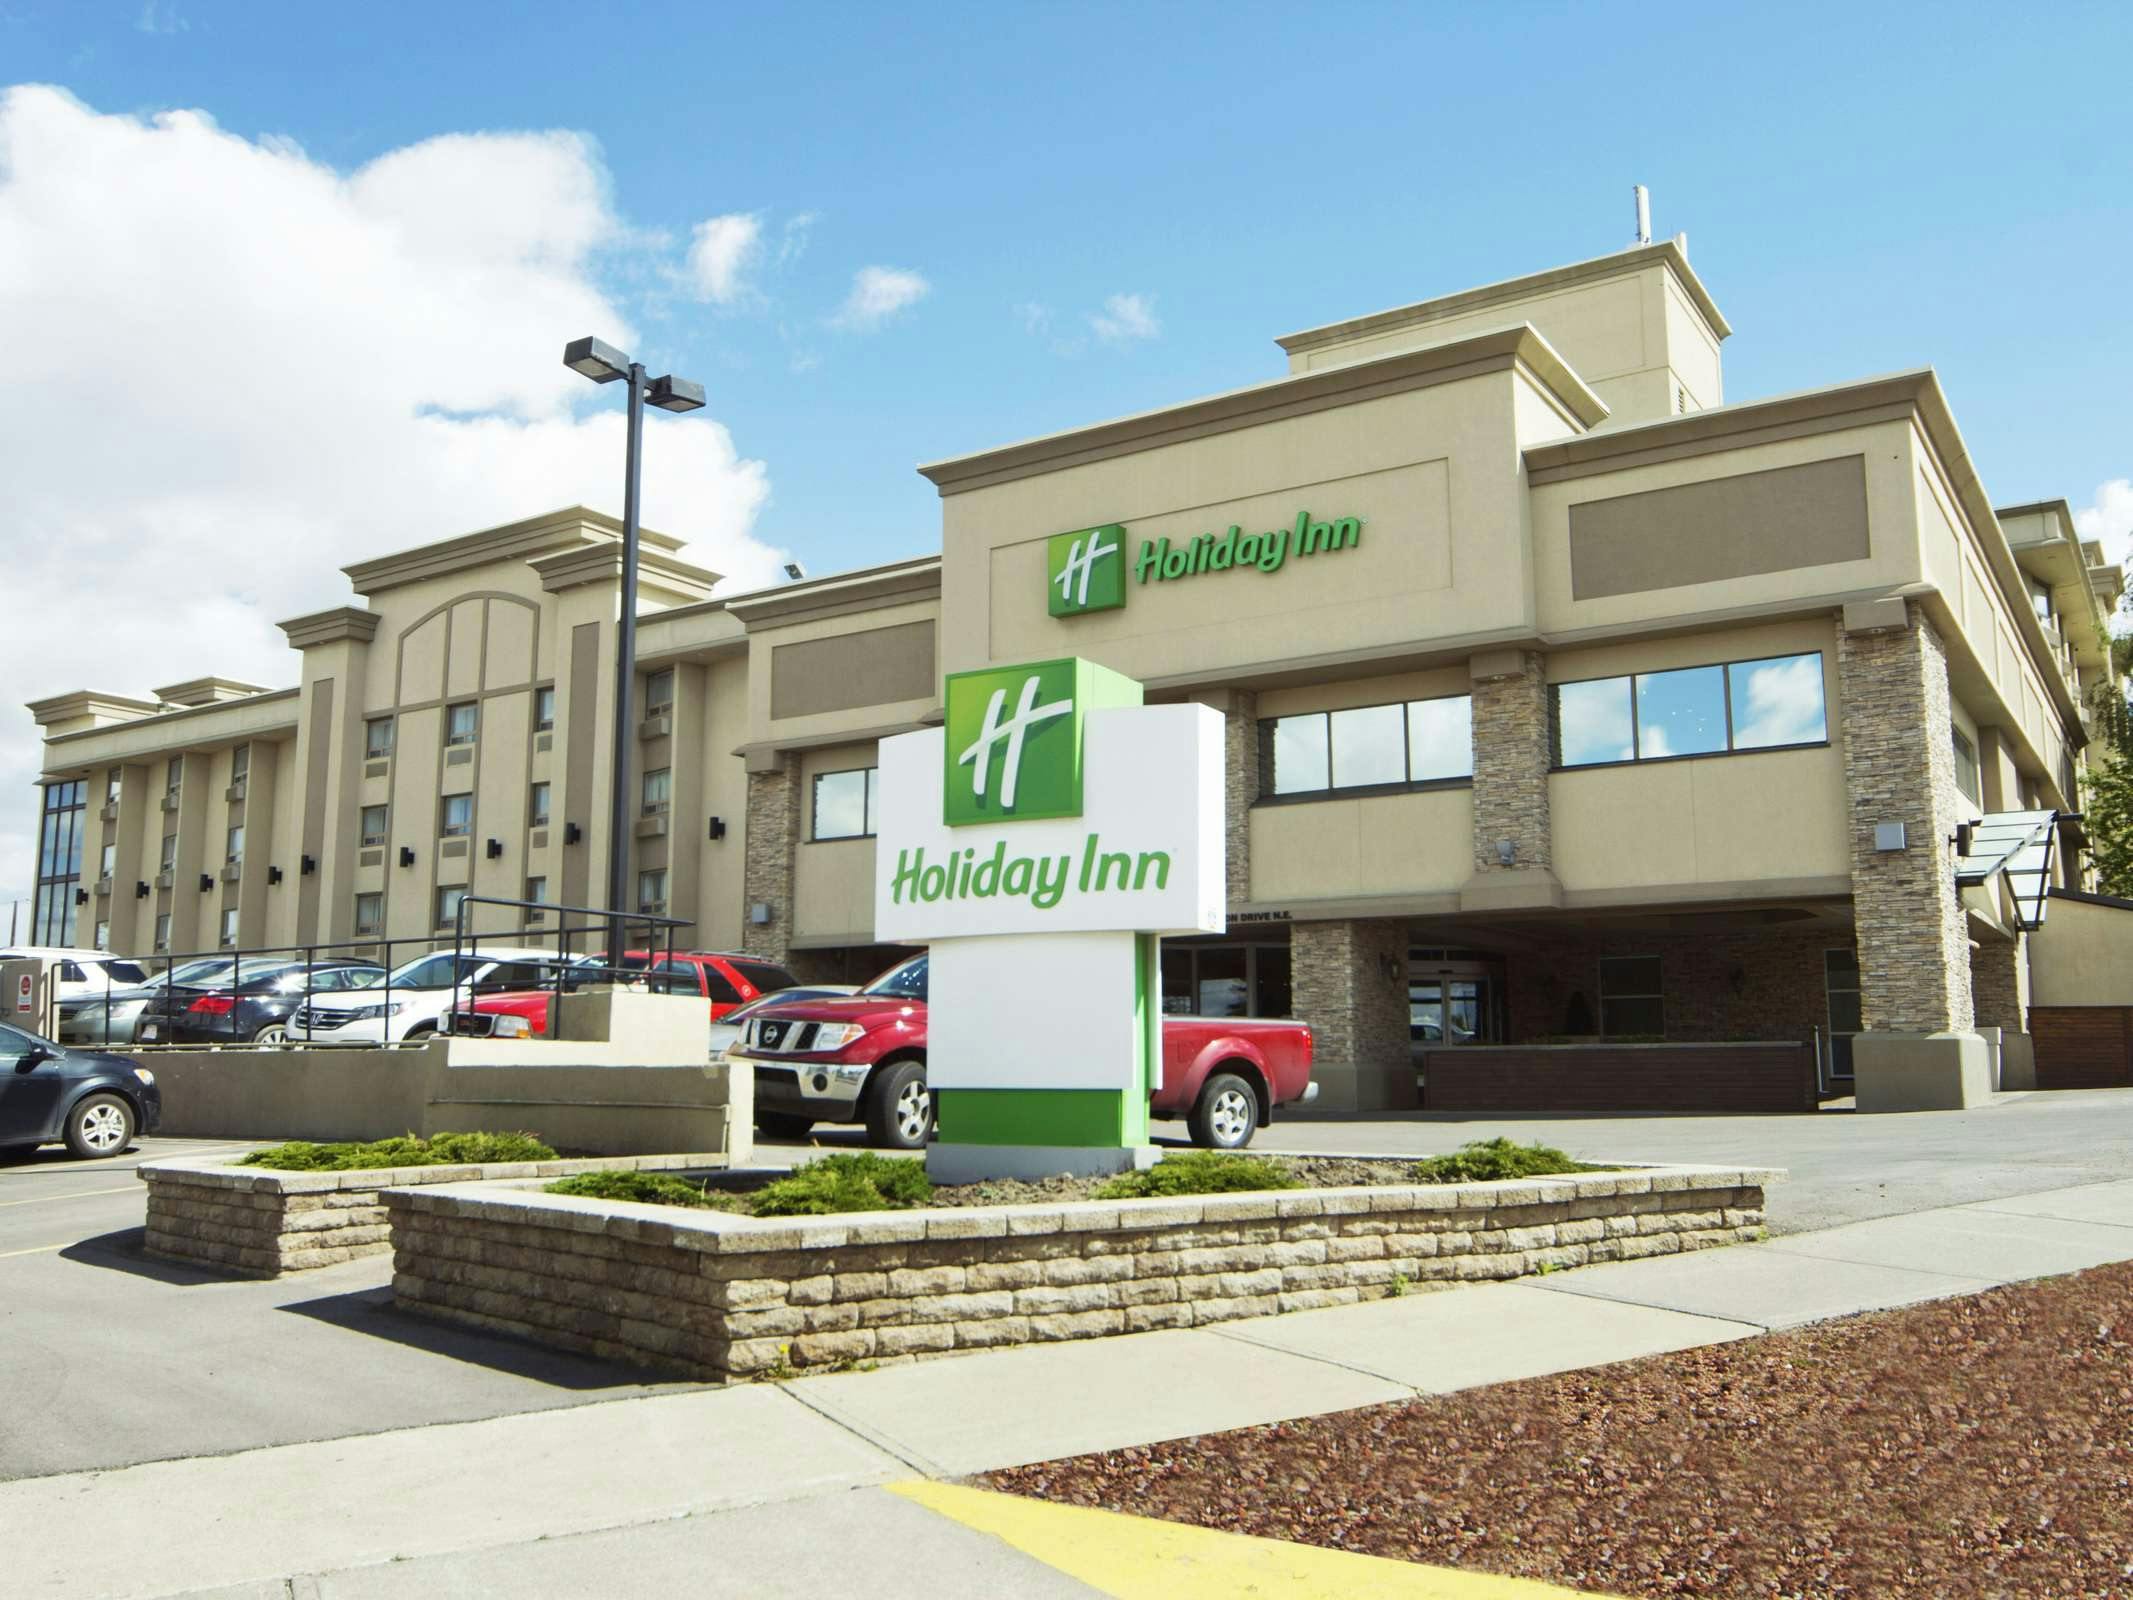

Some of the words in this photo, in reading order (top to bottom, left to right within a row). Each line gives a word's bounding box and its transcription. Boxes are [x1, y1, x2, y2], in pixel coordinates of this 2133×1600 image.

[1054, 531, 1118, 606] H
[1135, 525, 1289, 584] Holiday
[1292, 511, 1361, 557] Inn
[958, 675, 1074, 808] H
[891, 840, 1071, 909] Holiday
[1078, 833, 1171, 893] Inn
[1240, 912, 1271, 922] DRIVE
[1272, 910, 1293, 920] N.E.
